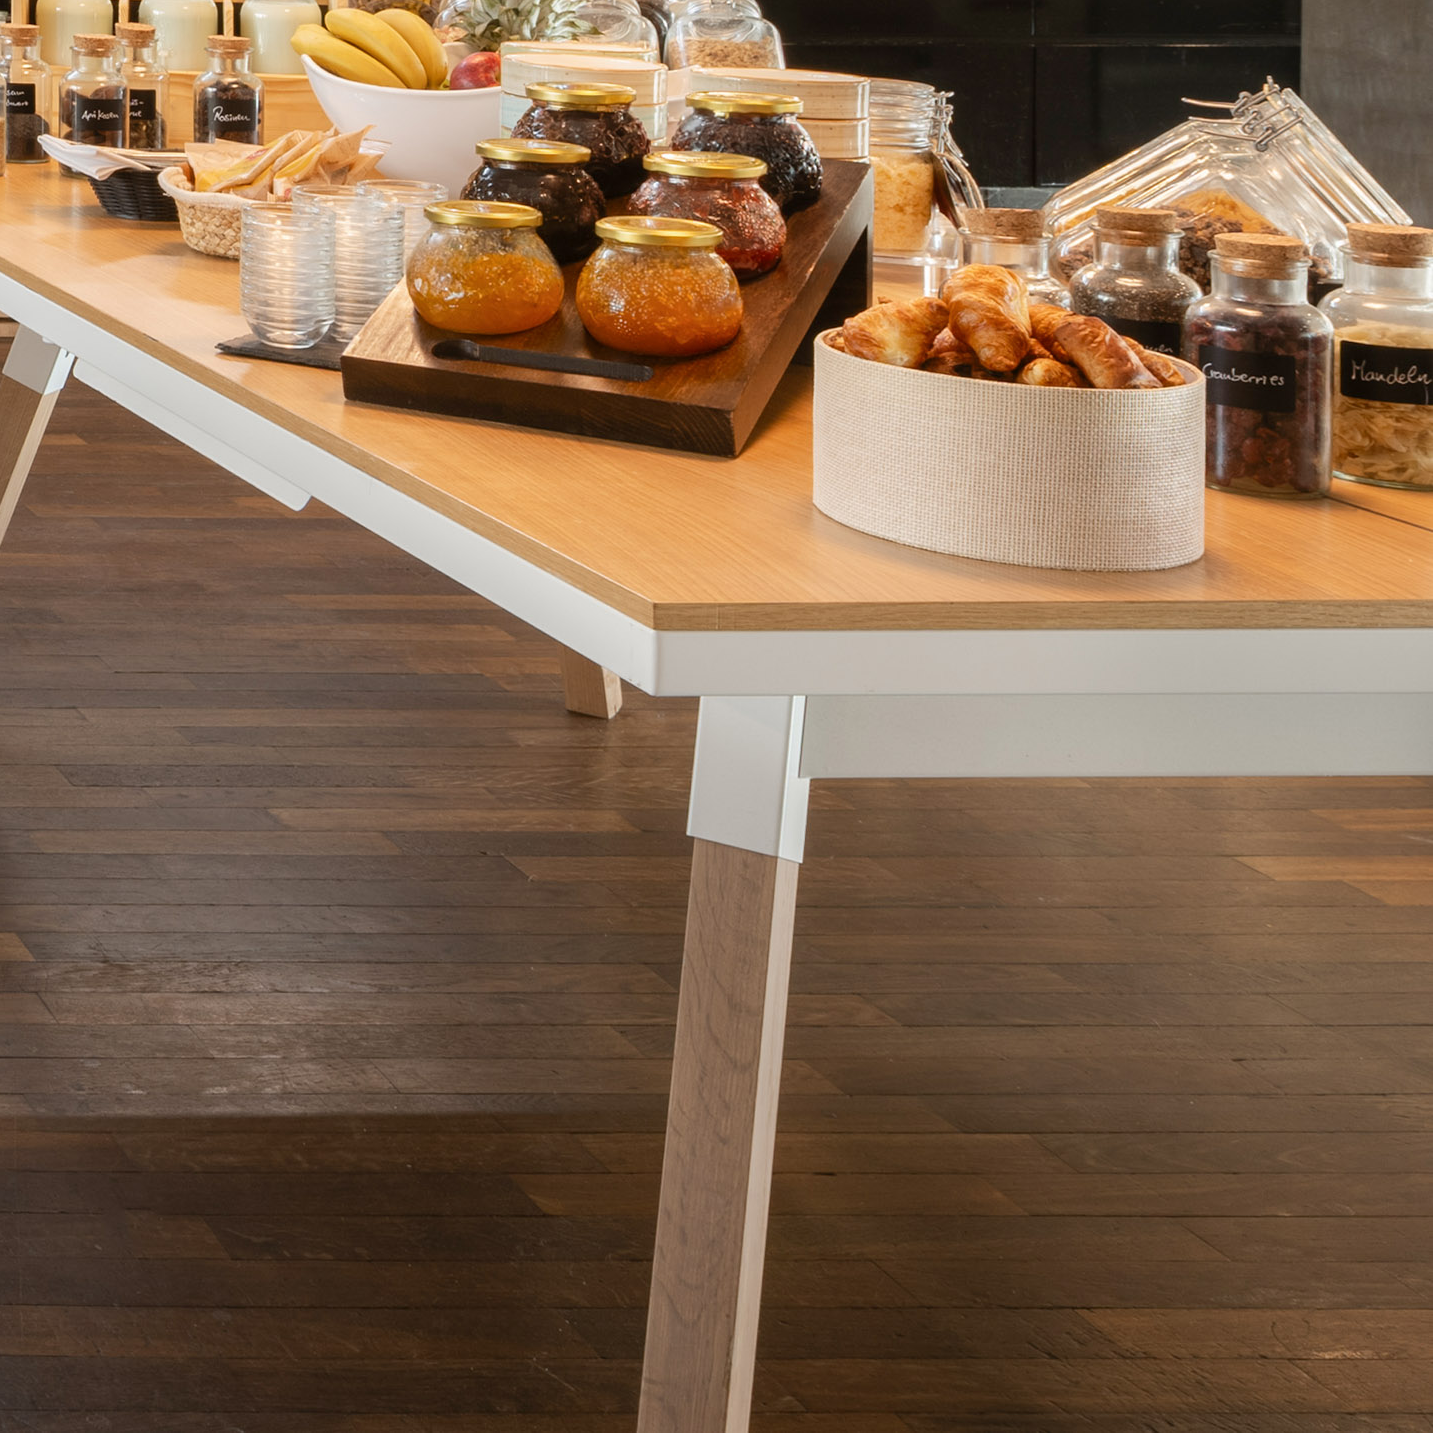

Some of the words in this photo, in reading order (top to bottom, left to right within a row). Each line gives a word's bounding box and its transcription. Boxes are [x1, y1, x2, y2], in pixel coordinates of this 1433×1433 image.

[212, 105, 251, 123] Rosinen
[1202, 363, 1285, 386] Cranberries
[1350, 359, 1433, 385] Mandeln
